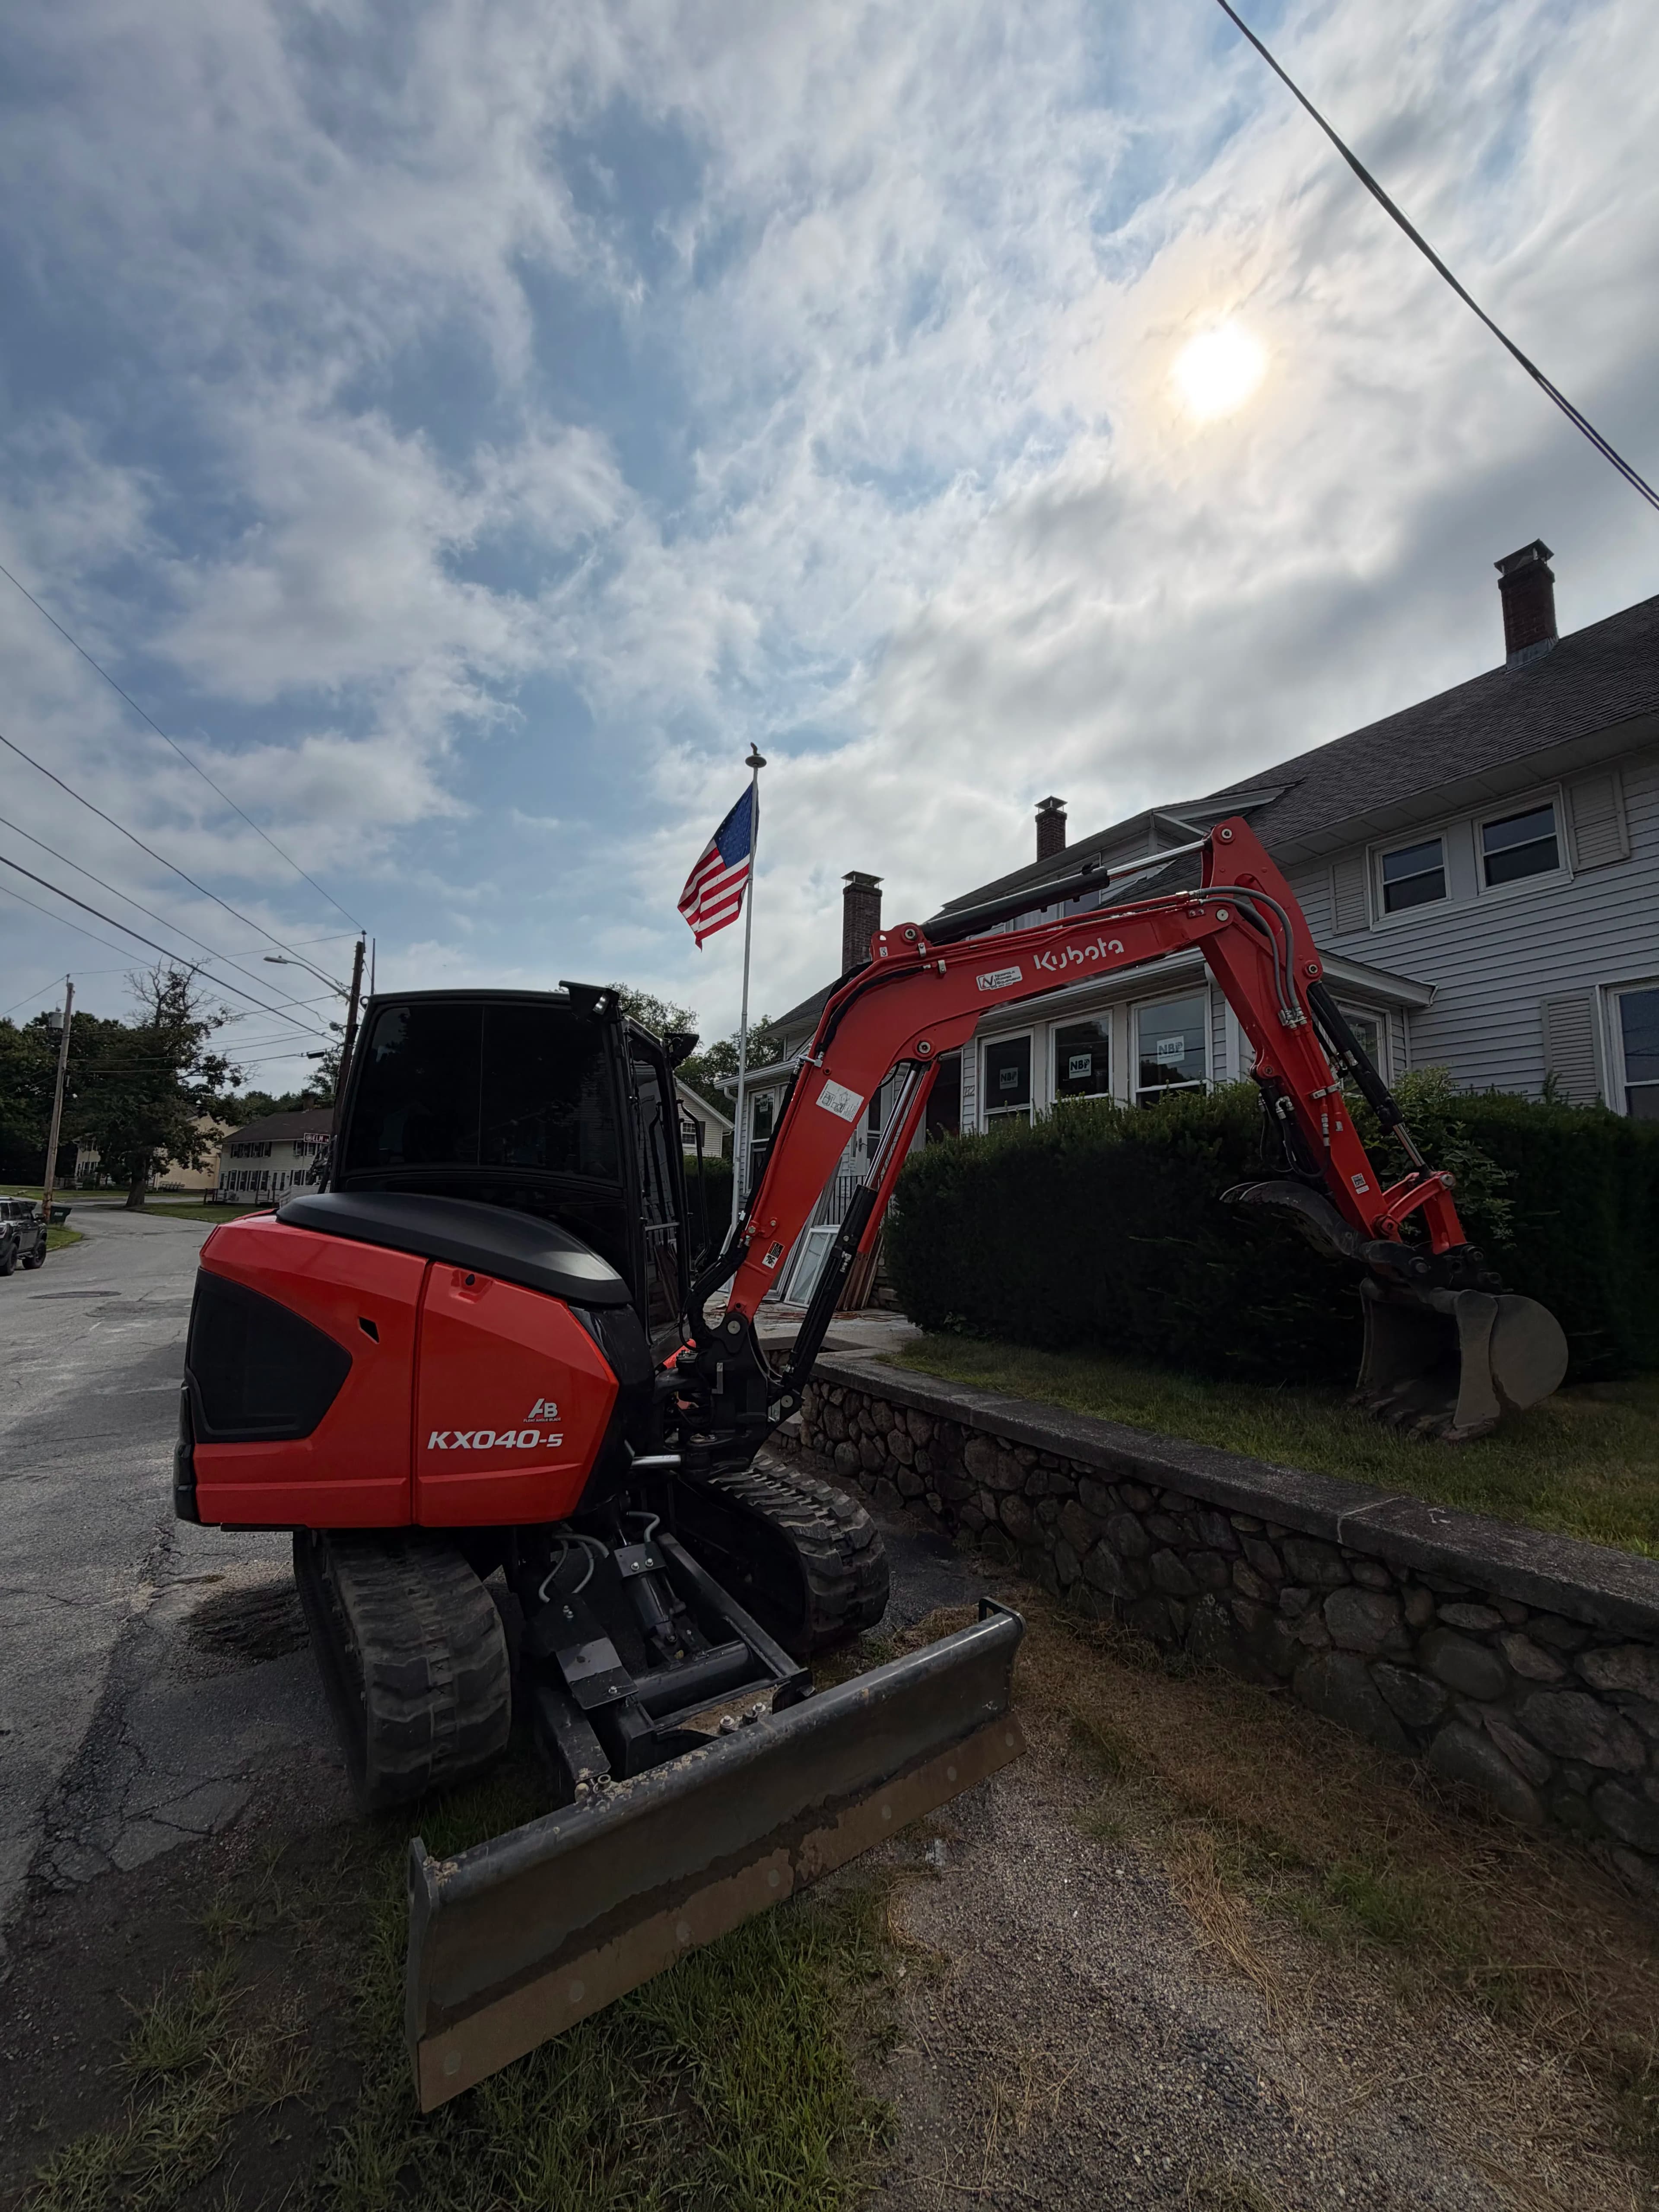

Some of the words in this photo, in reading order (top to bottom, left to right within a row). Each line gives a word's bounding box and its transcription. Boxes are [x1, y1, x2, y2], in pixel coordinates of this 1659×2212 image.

[1033, 937, 1125, 971] Kubota
[1159, 1042, 1183, 1055] NBP
[1071, 1059, 1090, 1071] NBP
[1001, 1071, 1017, 1082] NBP
[528, 1398, 558, 1418] AB
[427, 1430, 563, 1449] KX040-5
